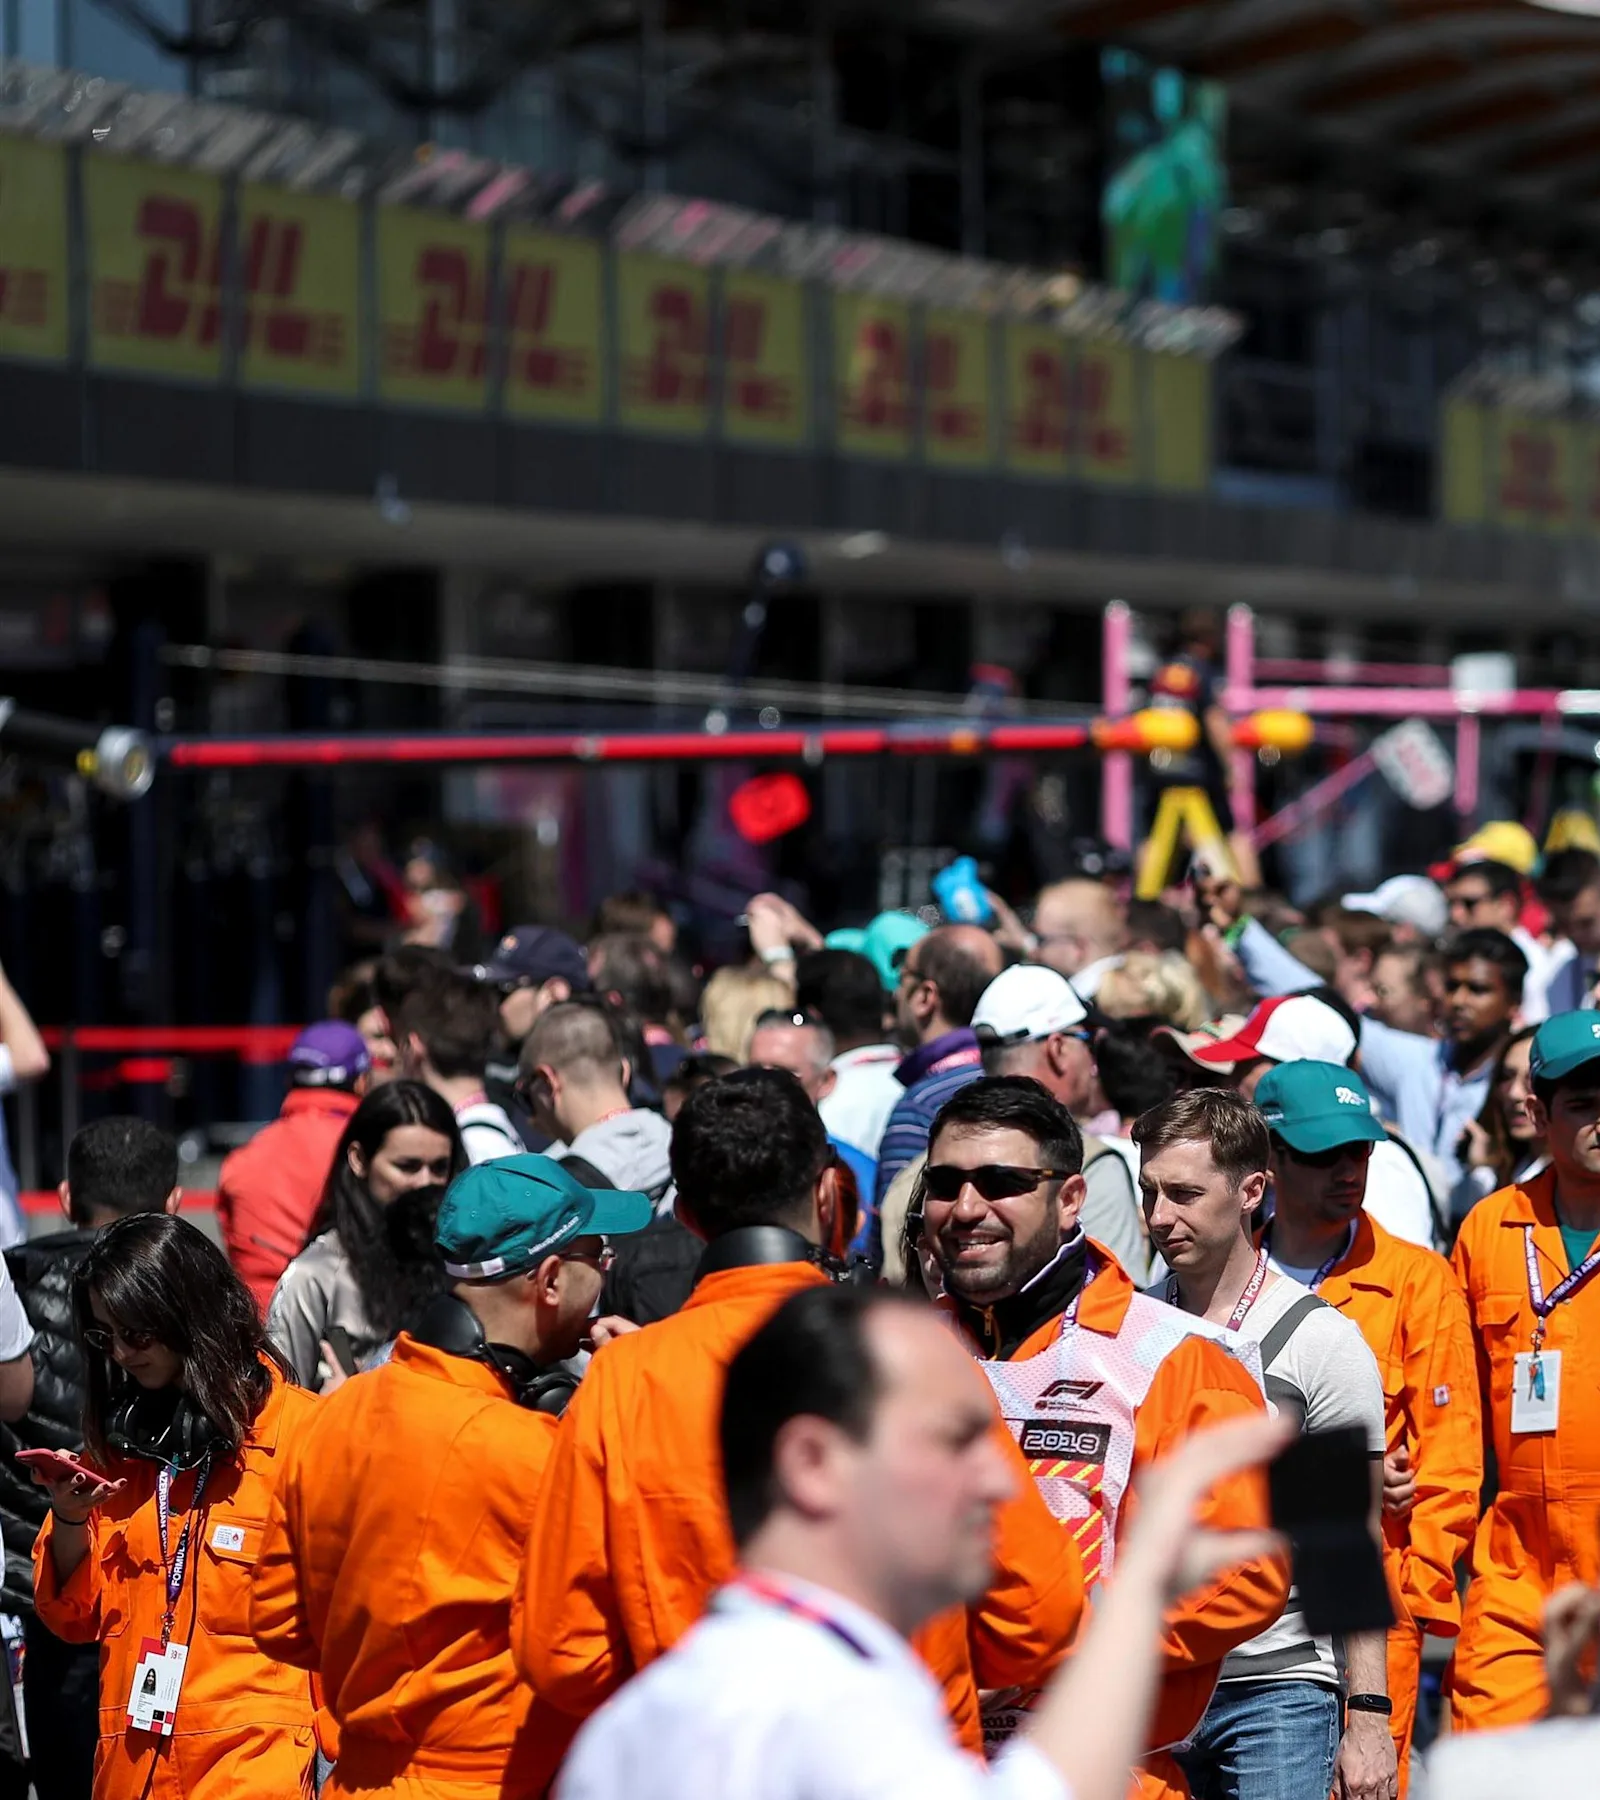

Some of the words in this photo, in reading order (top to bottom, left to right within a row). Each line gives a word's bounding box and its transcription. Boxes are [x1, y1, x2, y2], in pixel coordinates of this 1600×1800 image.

[136, 193, 305, 356] DHL
[1232, 1299, 1251, 1321] 2018
[1023, 1429, 1100, 1455] 2018
[170, 1539, 187, 1587] FORMULA
